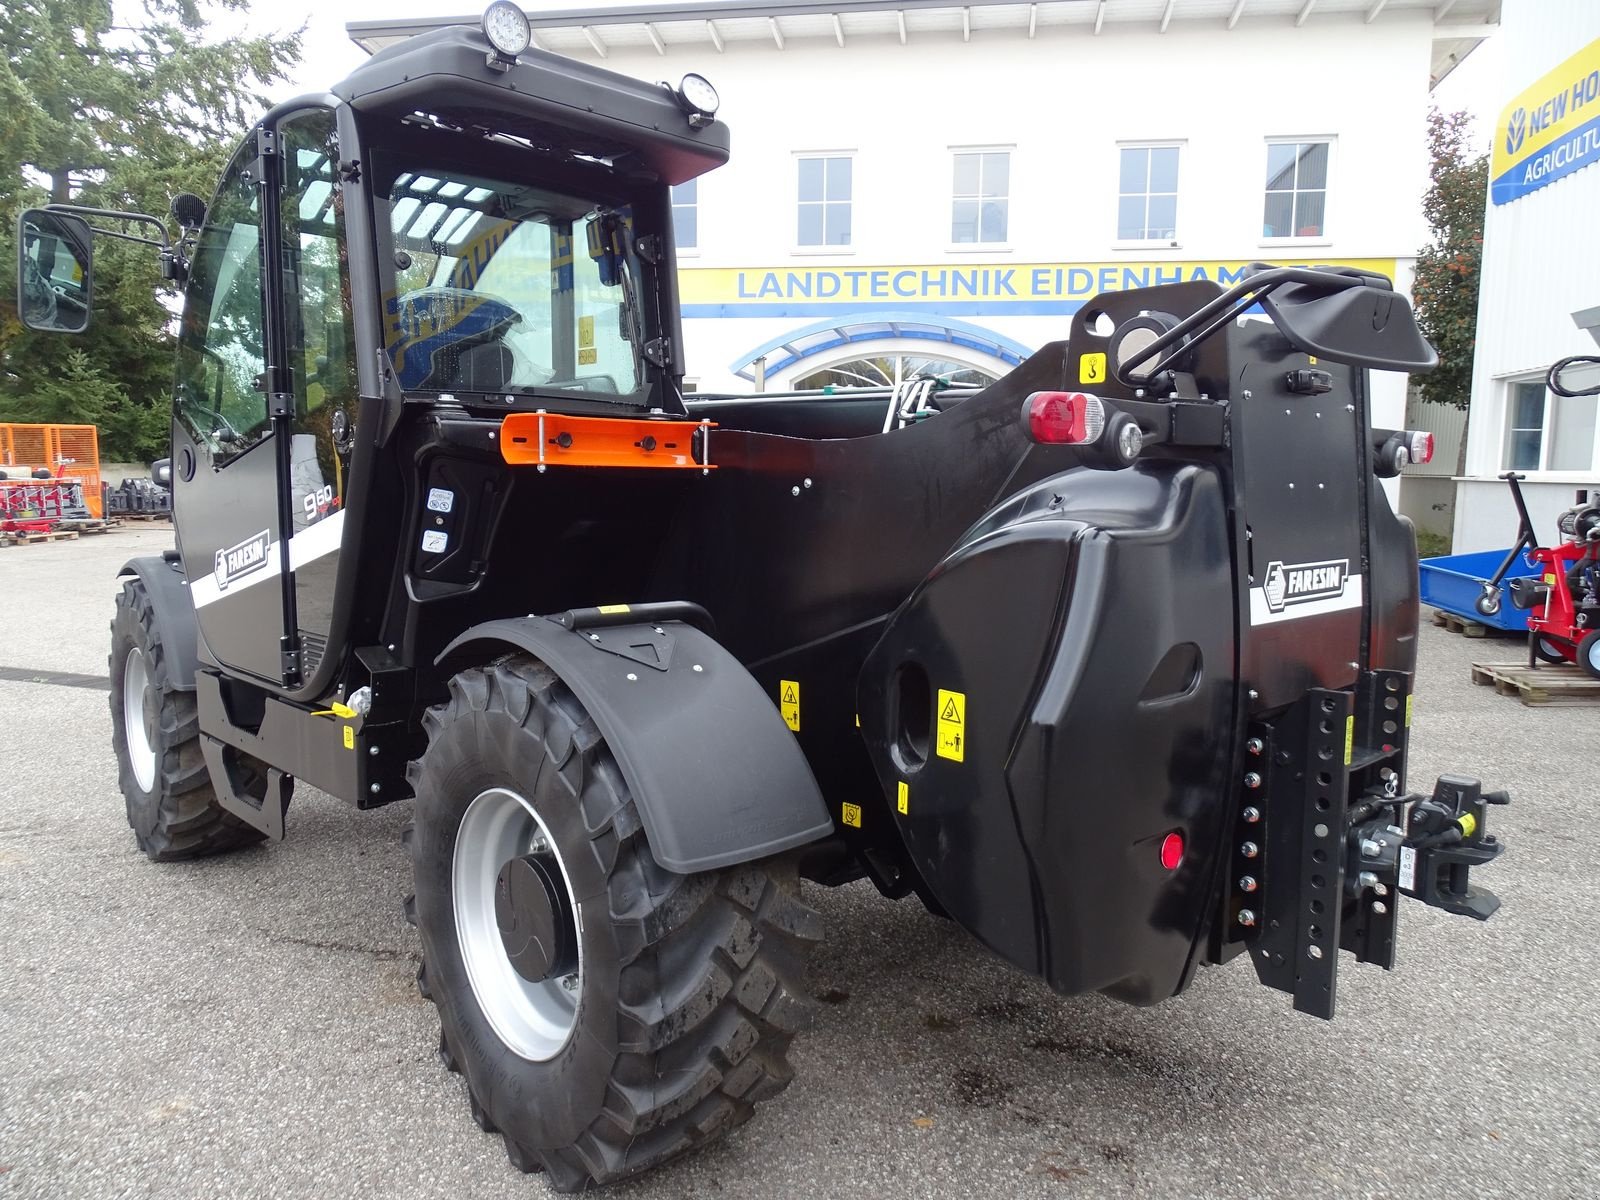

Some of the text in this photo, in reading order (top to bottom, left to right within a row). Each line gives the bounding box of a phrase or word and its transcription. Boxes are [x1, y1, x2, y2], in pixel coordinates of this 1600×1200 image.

[1529, 69, 1600, 138] NEW HO
[737, 269, 1018, 298] LANDTECHNIK
[303, 484, 332, 520] 960
[227, 538, 264, 574] FARESIN
[1287, 566, 1341, 594] FARESIN
